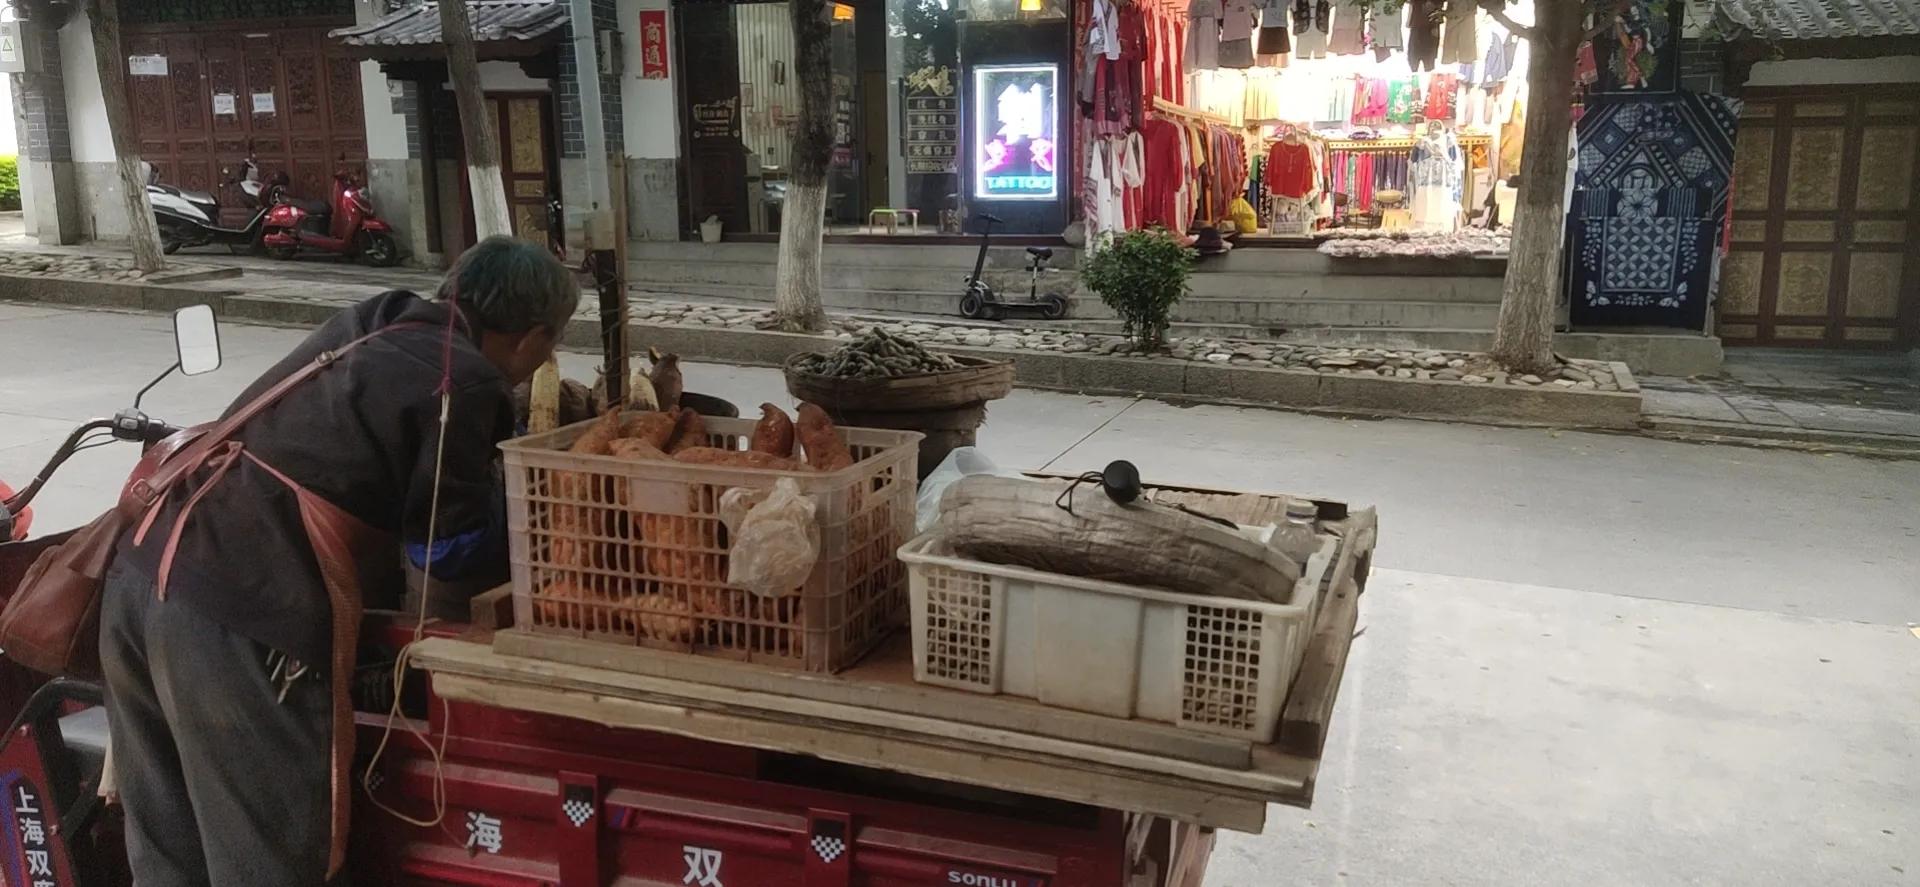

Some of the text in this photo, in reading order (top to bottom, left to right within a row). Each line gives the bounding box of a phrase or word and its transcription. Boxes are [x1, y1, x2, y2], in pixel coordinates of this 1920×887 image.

[984, 175, 1051, 189] TATTOO
[465, 811, 723, 887] 海 双
